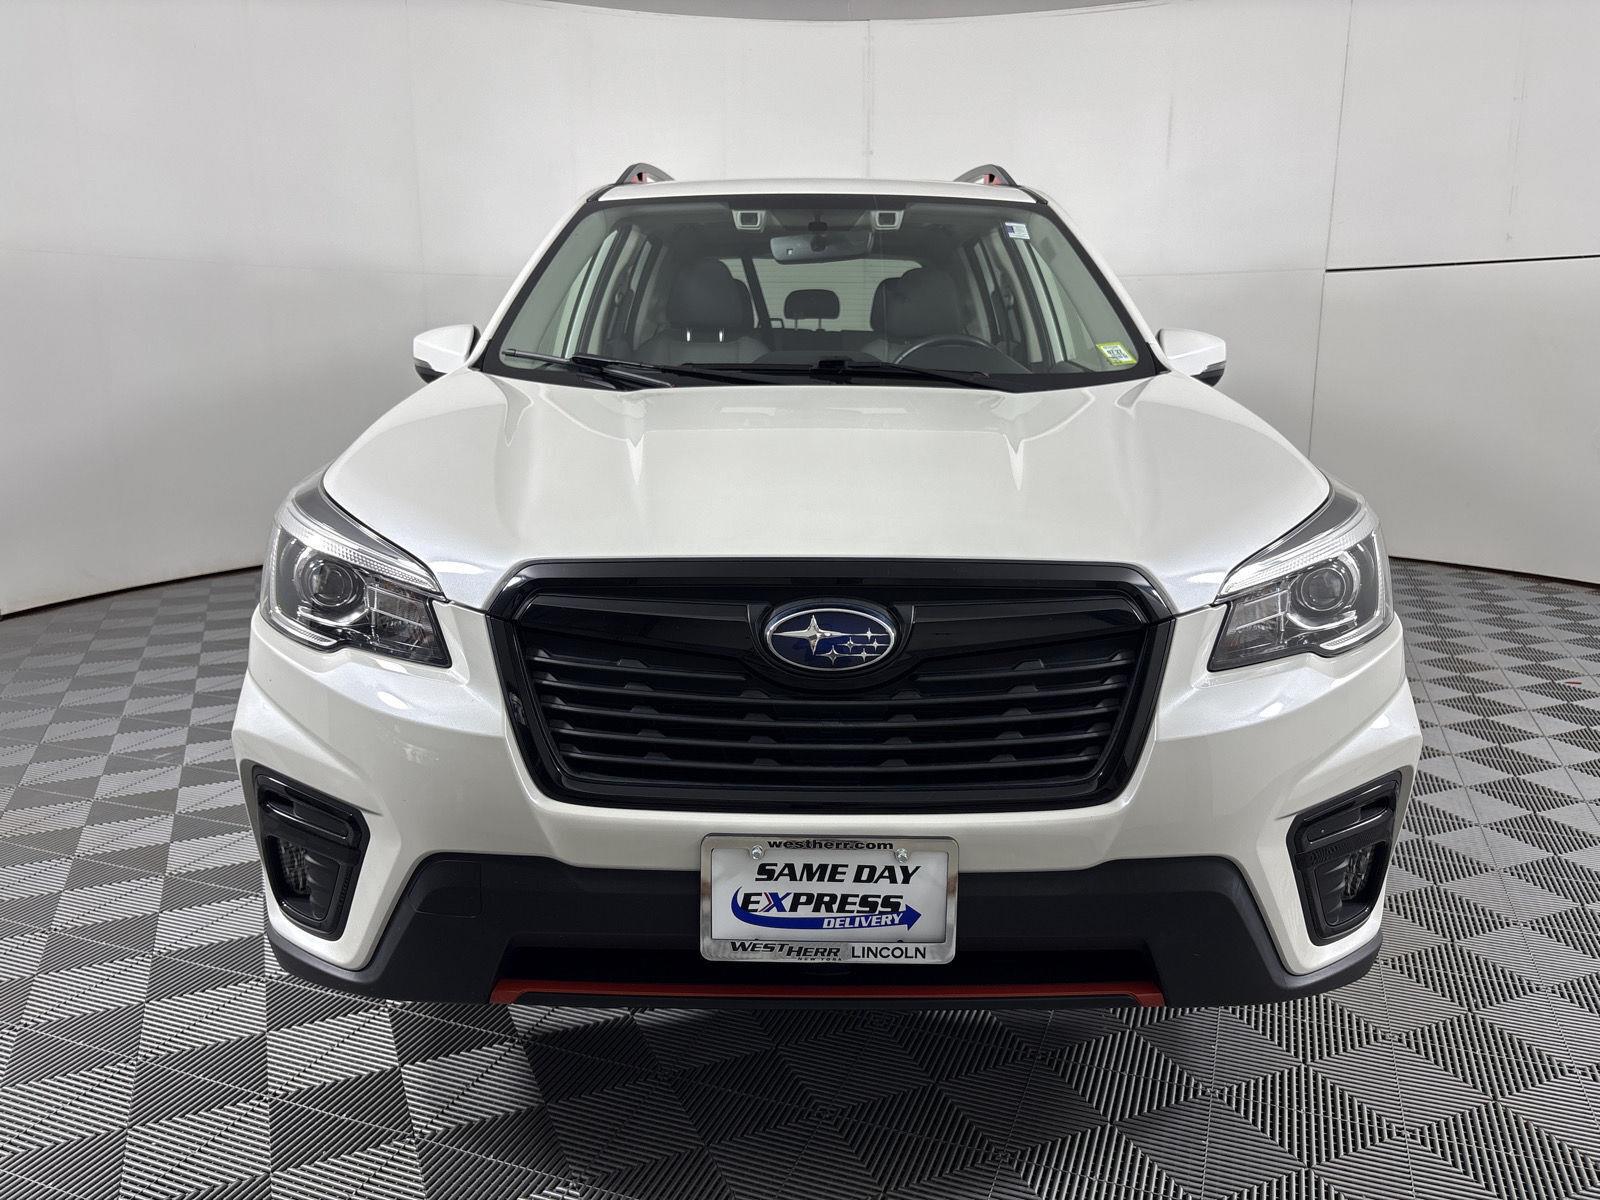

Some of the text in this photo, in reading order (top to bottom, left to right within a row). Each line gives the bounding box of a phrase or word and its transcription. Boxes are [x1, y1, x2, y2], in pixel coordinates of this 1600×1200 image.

[768, 839, 893, 850] westherr.com
[755, 862, 922, 885] SAME DAY
[740, 892, 904, 914] EXPRESS
[822, 912, 904, 929] DELIVERY
[851, 946, 927, 960] LINCOLN
